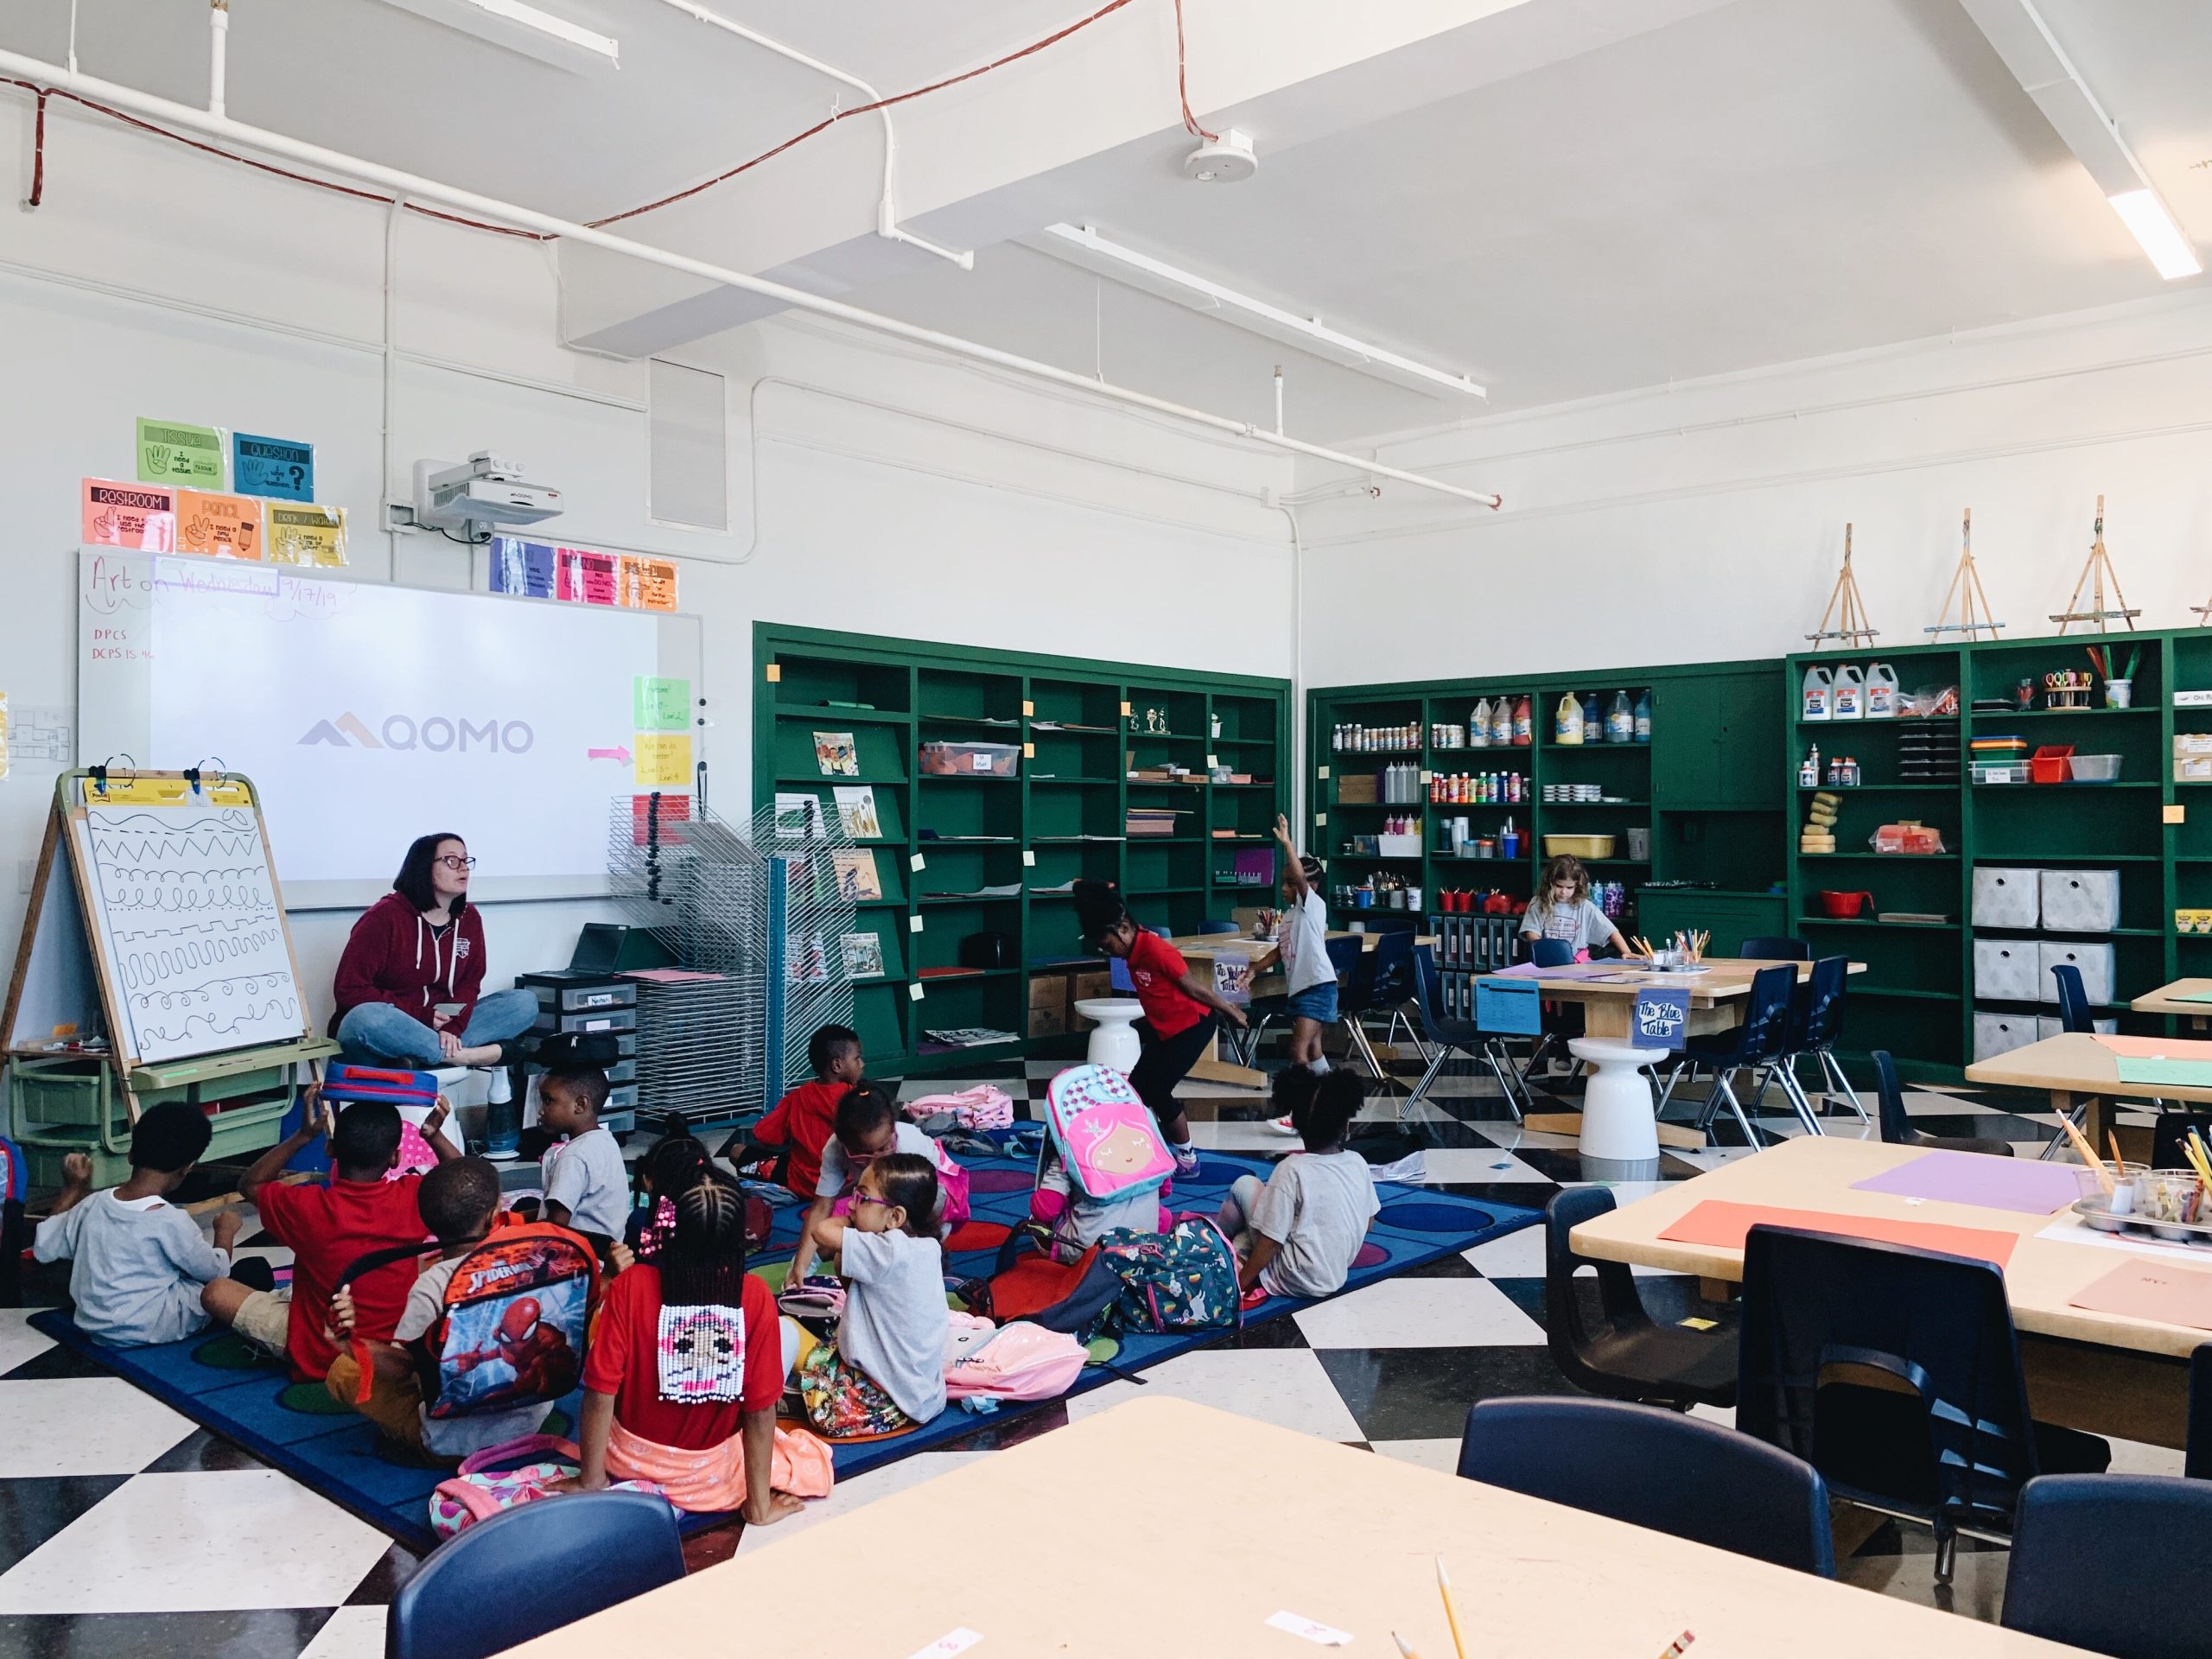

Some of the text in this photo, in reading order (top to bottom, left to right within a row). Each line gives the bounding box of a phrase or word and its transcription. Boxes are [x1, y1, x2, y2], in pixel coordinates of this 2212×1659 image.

[93, 556, 130, 607] Art
[282, 578, 337, 607] 9/17/19
[94, 629, 127, 639] DPCS
[92, 648, 122, 659] DCPS
[382, 715, 534, 754] QOMO
[1640, 1001, 1681, 1019] The Blue
[1642, 1019, 1670, 1036] Table
